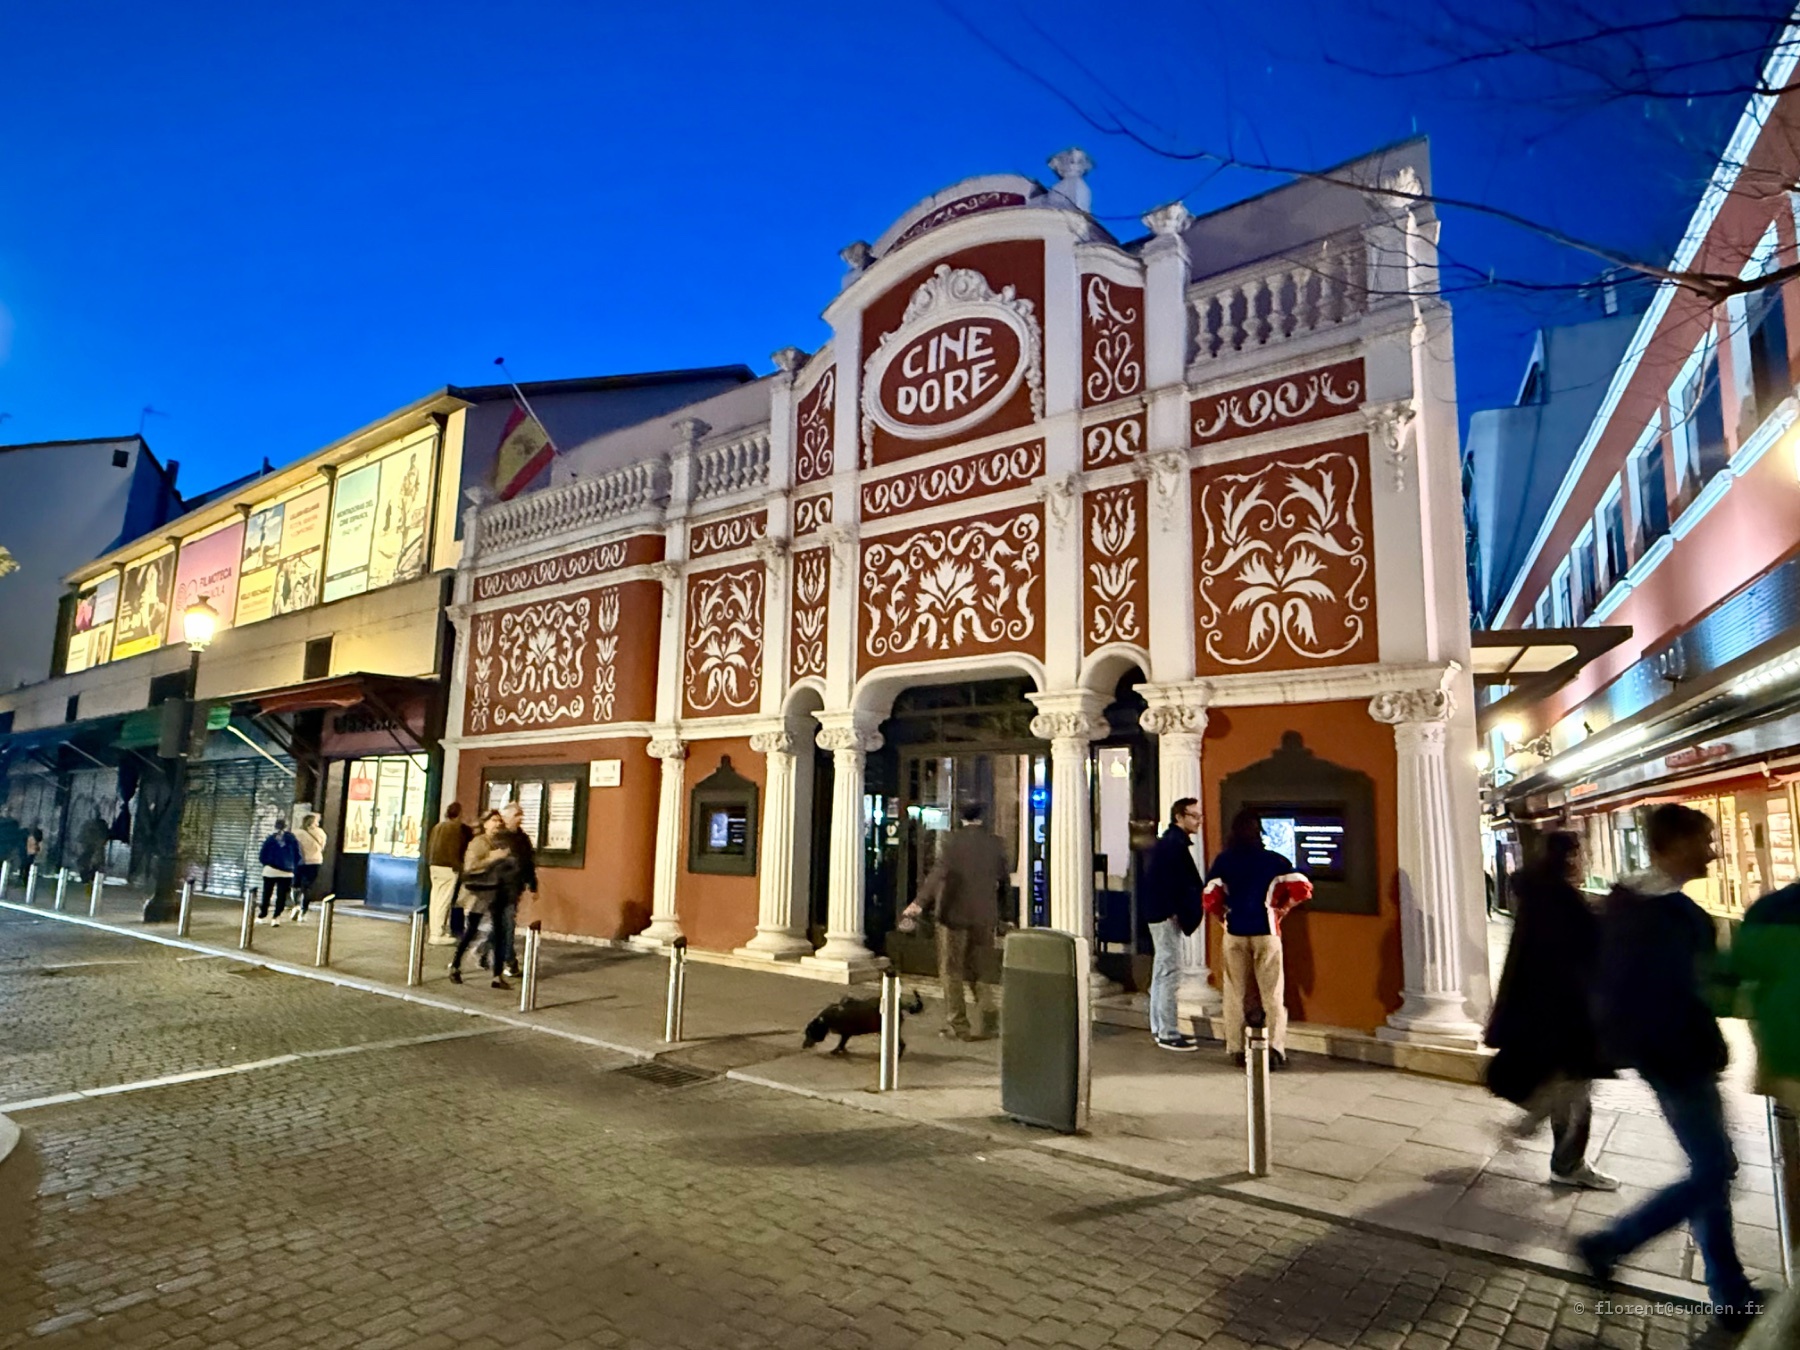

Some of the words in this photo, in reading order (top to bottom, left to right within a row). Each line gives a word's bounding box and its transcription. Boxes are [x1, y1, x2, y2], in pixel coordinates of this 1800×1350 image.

[902, 326, 994, 379] CINE
[897, 359, 999, 416] DORE
[199, 566, 232, 586] FILMOTECA
